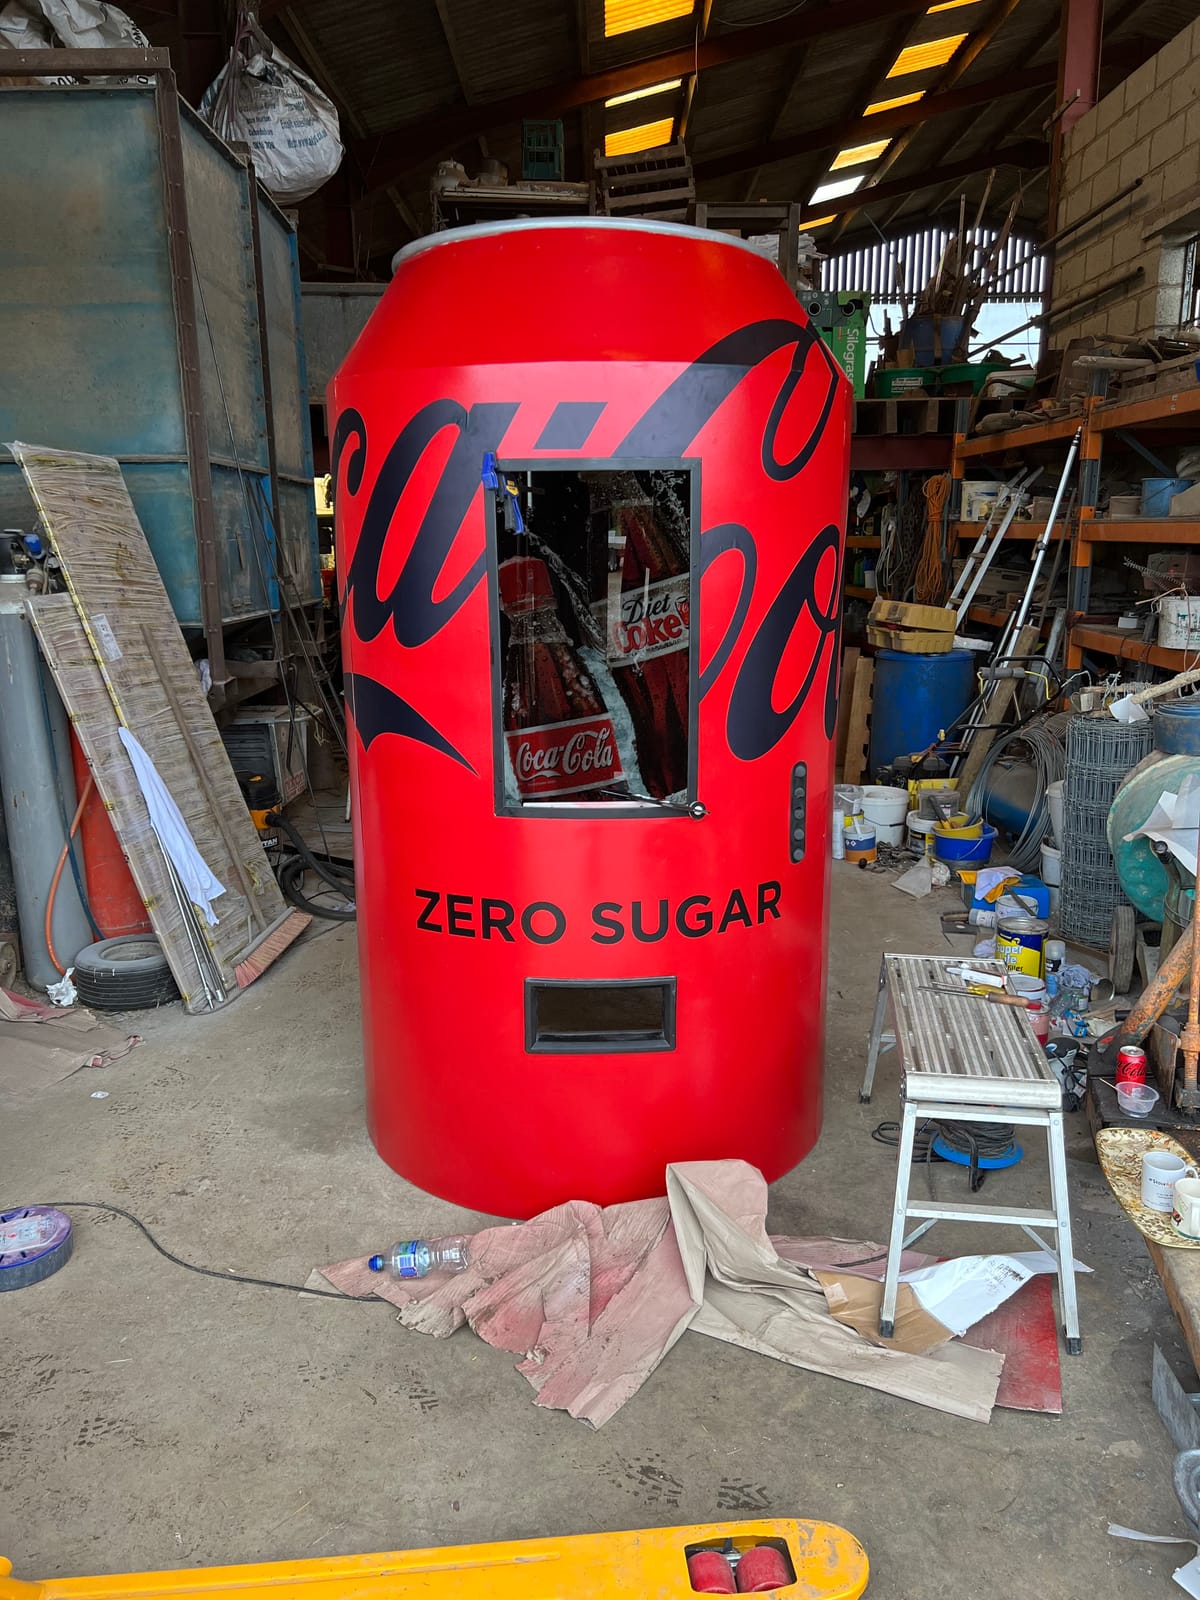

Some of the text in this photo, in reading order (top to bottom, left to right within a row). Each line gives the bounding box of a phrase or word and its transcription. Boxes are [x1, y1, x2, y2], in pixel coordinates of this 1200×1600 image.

[842, 328, 859, 384] Silogras
[612, 614, 682, 653] Coke
[622, 593, 671, 625] Diet
[516, 727, 614, 781] Coca-Cola
[415, 880, 782, 945] ZERO SUGAR
